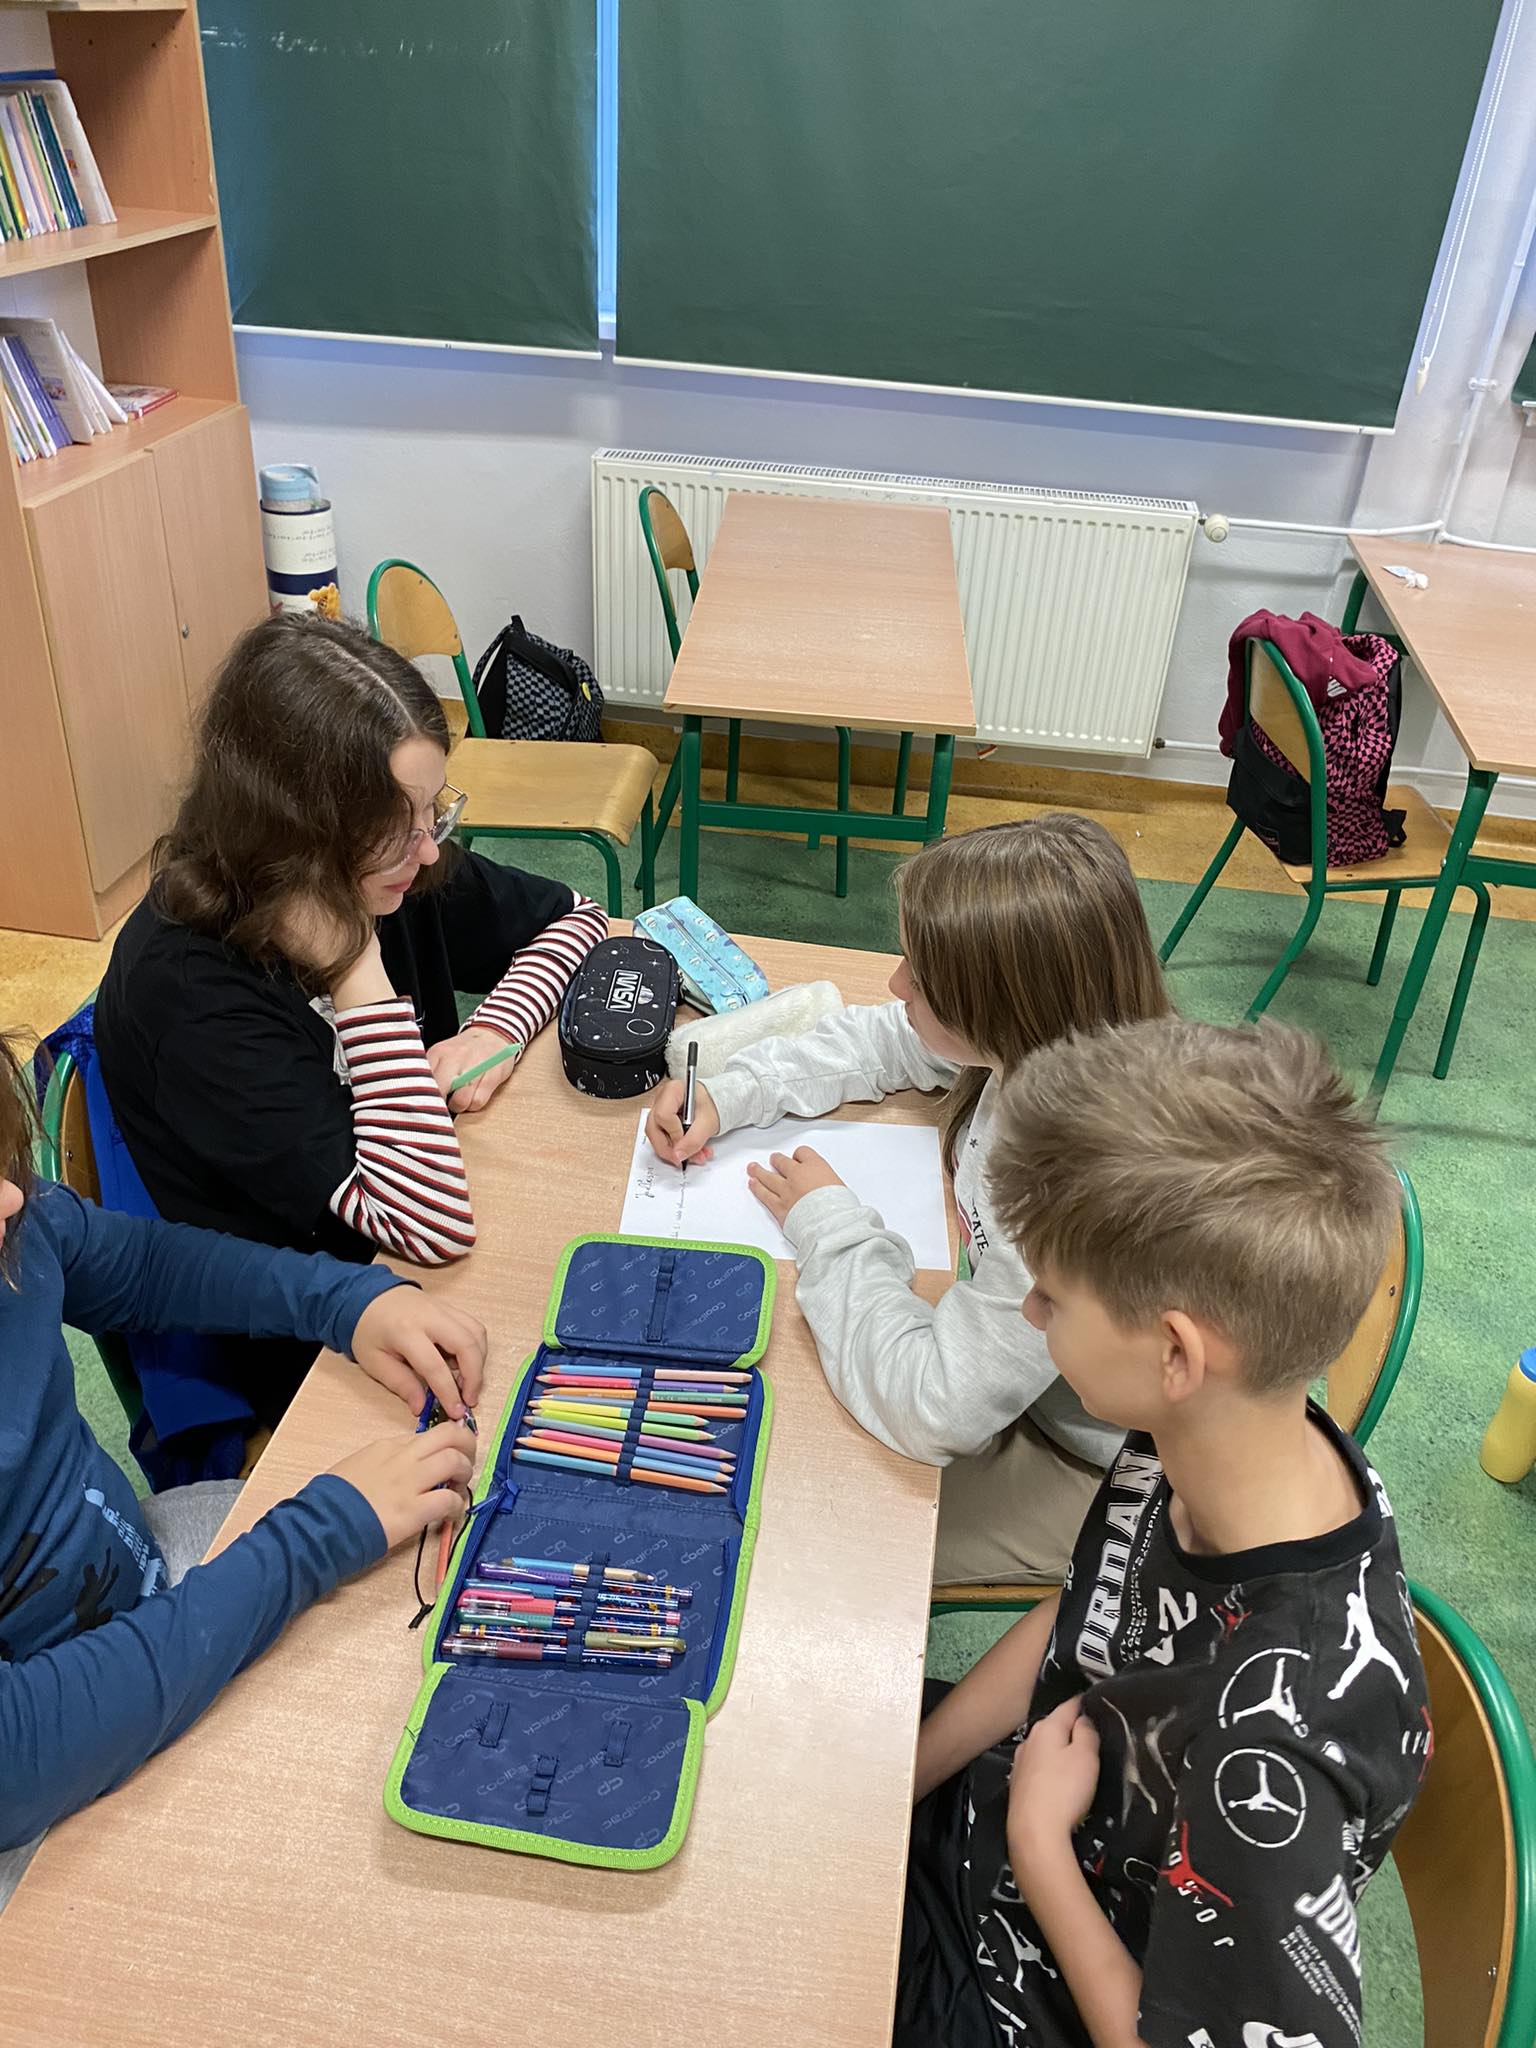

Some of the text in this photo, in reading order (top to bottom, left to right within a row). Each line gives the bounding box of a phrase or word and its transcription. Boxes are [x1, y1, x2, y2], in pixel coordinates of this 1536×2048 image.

[608, 972, 639, 1009] NASA
[707, 1258, 752, 1289] CoolPac
[1076, 1449, 1163, 1677] ORDAN
[598, 1777, 624, 1796] CP
